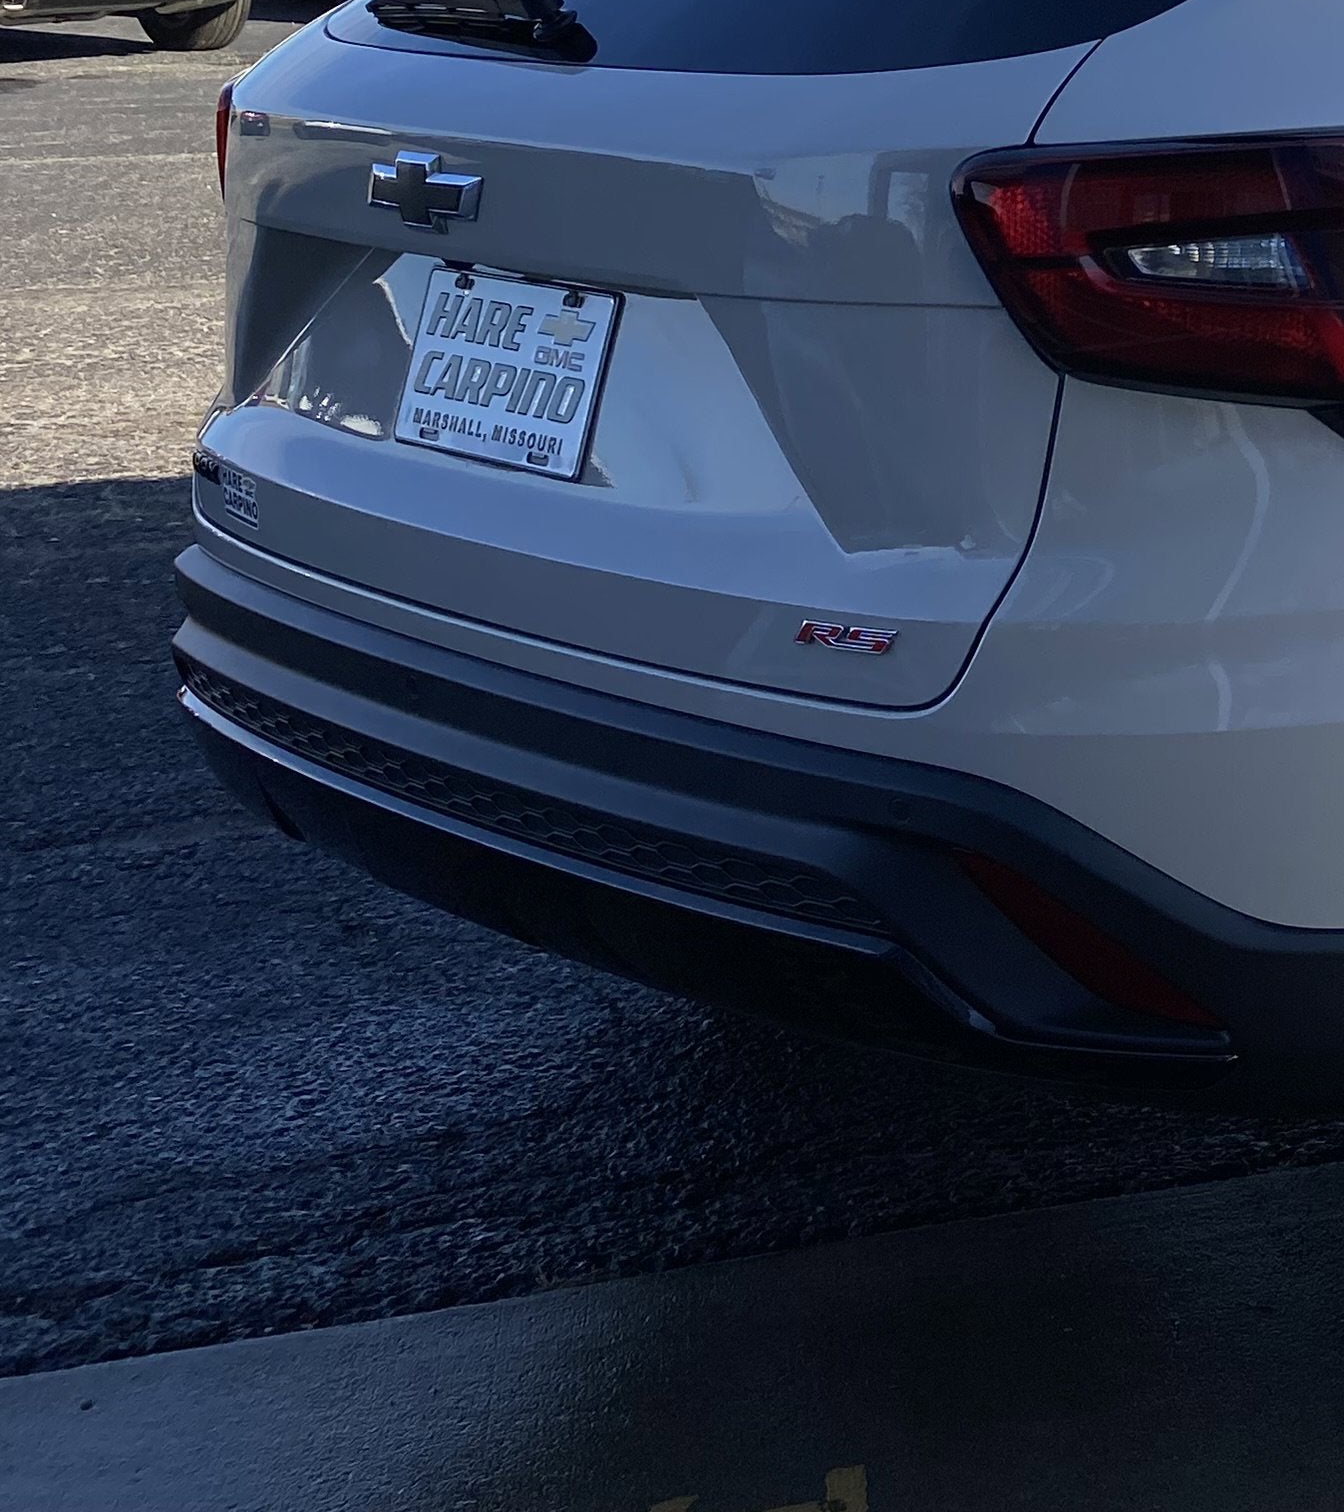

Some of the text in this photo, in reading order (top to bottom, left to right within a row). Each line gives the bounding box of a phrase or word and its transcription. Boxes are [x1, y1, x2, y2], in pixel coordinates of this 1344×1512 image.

[426, 292, 534, 351] HARE
[534, 345, 585, 372] GMC
[413, 350, 586, 424] CARPINO
[412, 407, 563, 455] MARSHALL, MISSOURI
[795, 619, 898, 654] RS
